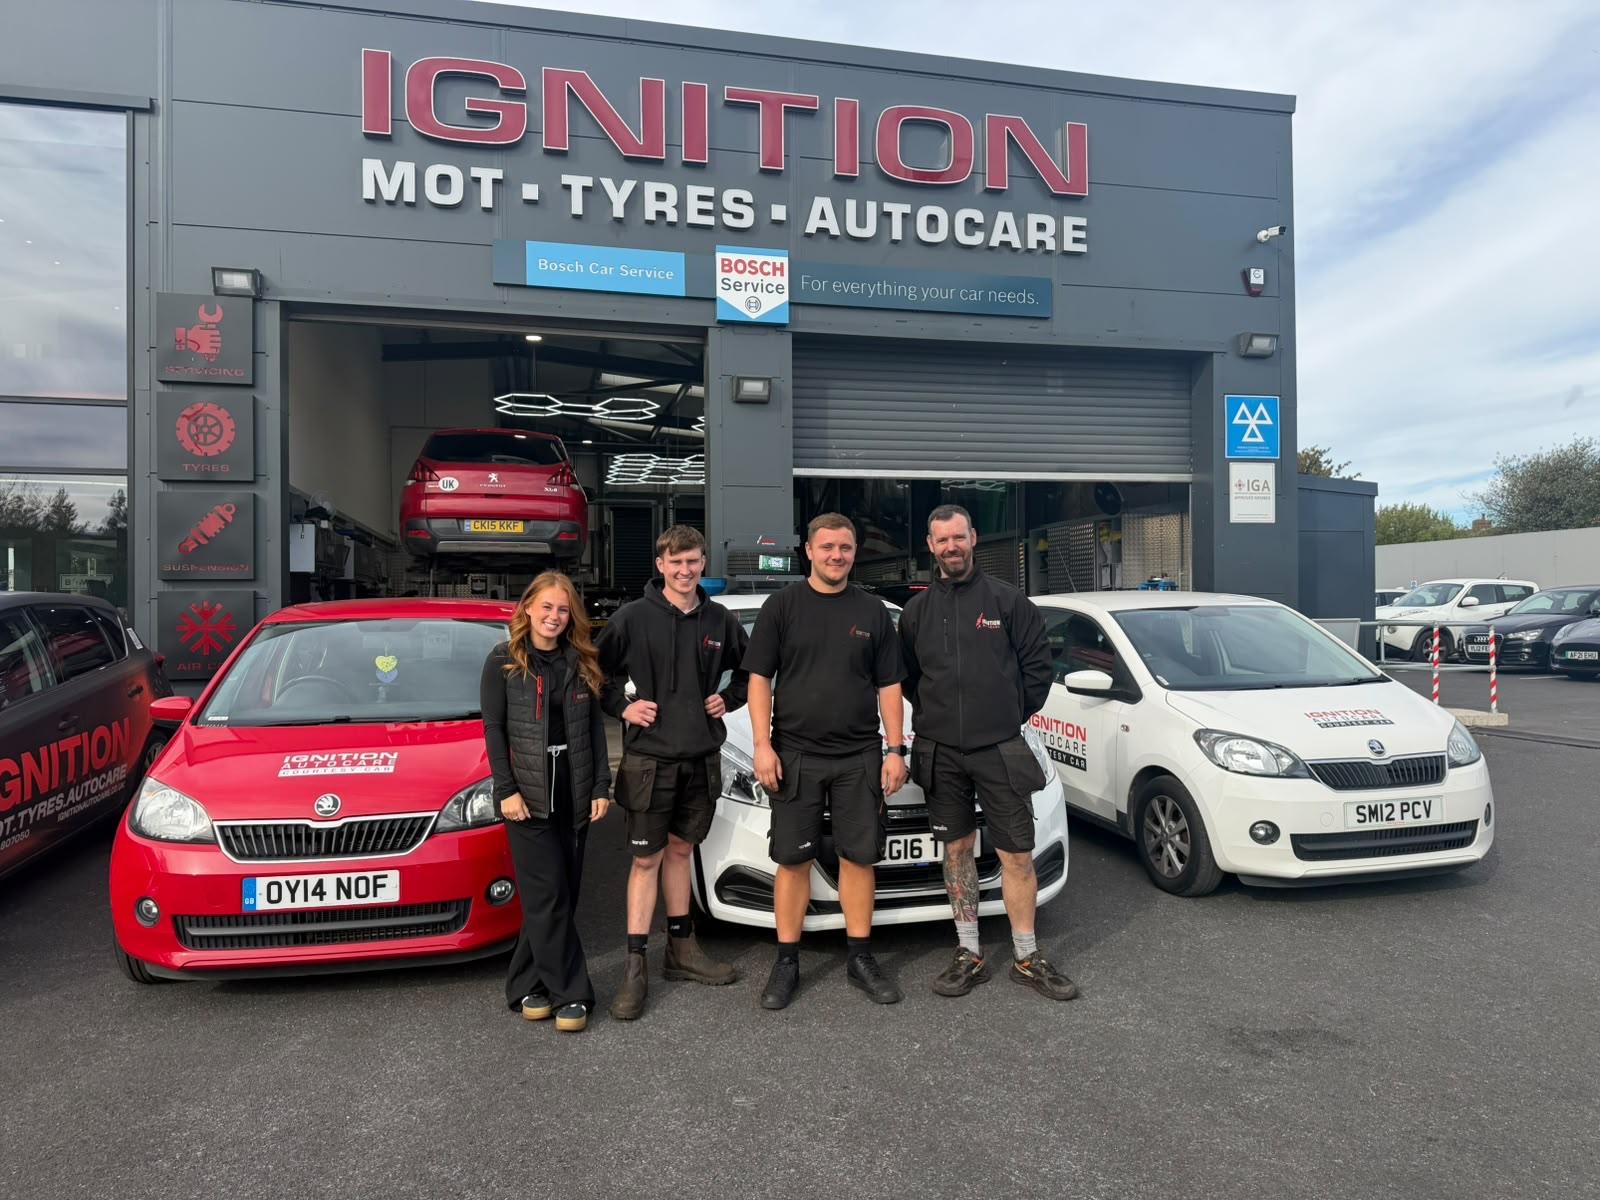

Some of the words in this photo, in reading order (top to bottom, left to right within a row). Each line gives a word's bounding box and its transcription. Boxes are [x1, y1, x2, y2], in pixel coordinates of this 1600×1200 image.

[361, 47, 1088, 196] IGNITION
[361, 158, 504, 209] MOT
[561, 174, 754, 228] TYRES
[804, 196, 1087, 253] AUTOCARE
[538, 258, 584, 273] Bosch
[589, 262, 614, 275] Car
[619, 264, 674, 280] Service
[720, 257, 785, 277] BOSCH
[720, 277, 785, 294] Service
[801, 274, 828, 291] For
[832, 279, 918, 300] everything
[921, 286, 956, 301] your
[959, 287, 983, 301] car
[988, 288, 1039, 304] needs.
[182, 463, 230, 472] TYRES
[441, 479, 455, 489] UK
[1247, 479, 1271, 492] IGA
[473, 520, 497, 530] CK15
[499, 521, 519, 531] KKF
[177, 662, 202, 671] AIR
[1304, 709, 1381, 718] IGNITION
[1036, 730, 1087, 756] TOCARE
[281, 758, 396, 769] AUTOCARE
[283, 752, 399, 763] IGNITION
[1069, 757, 1086, 769] CAR
[1356, 802, 1395, 823] SM12
[1400, 800, 1432, 820] PCV
[882, 838, 922, 860] G16
[266, 878, 327, 904] OY14
[336, 874, 388, 901] NOF
